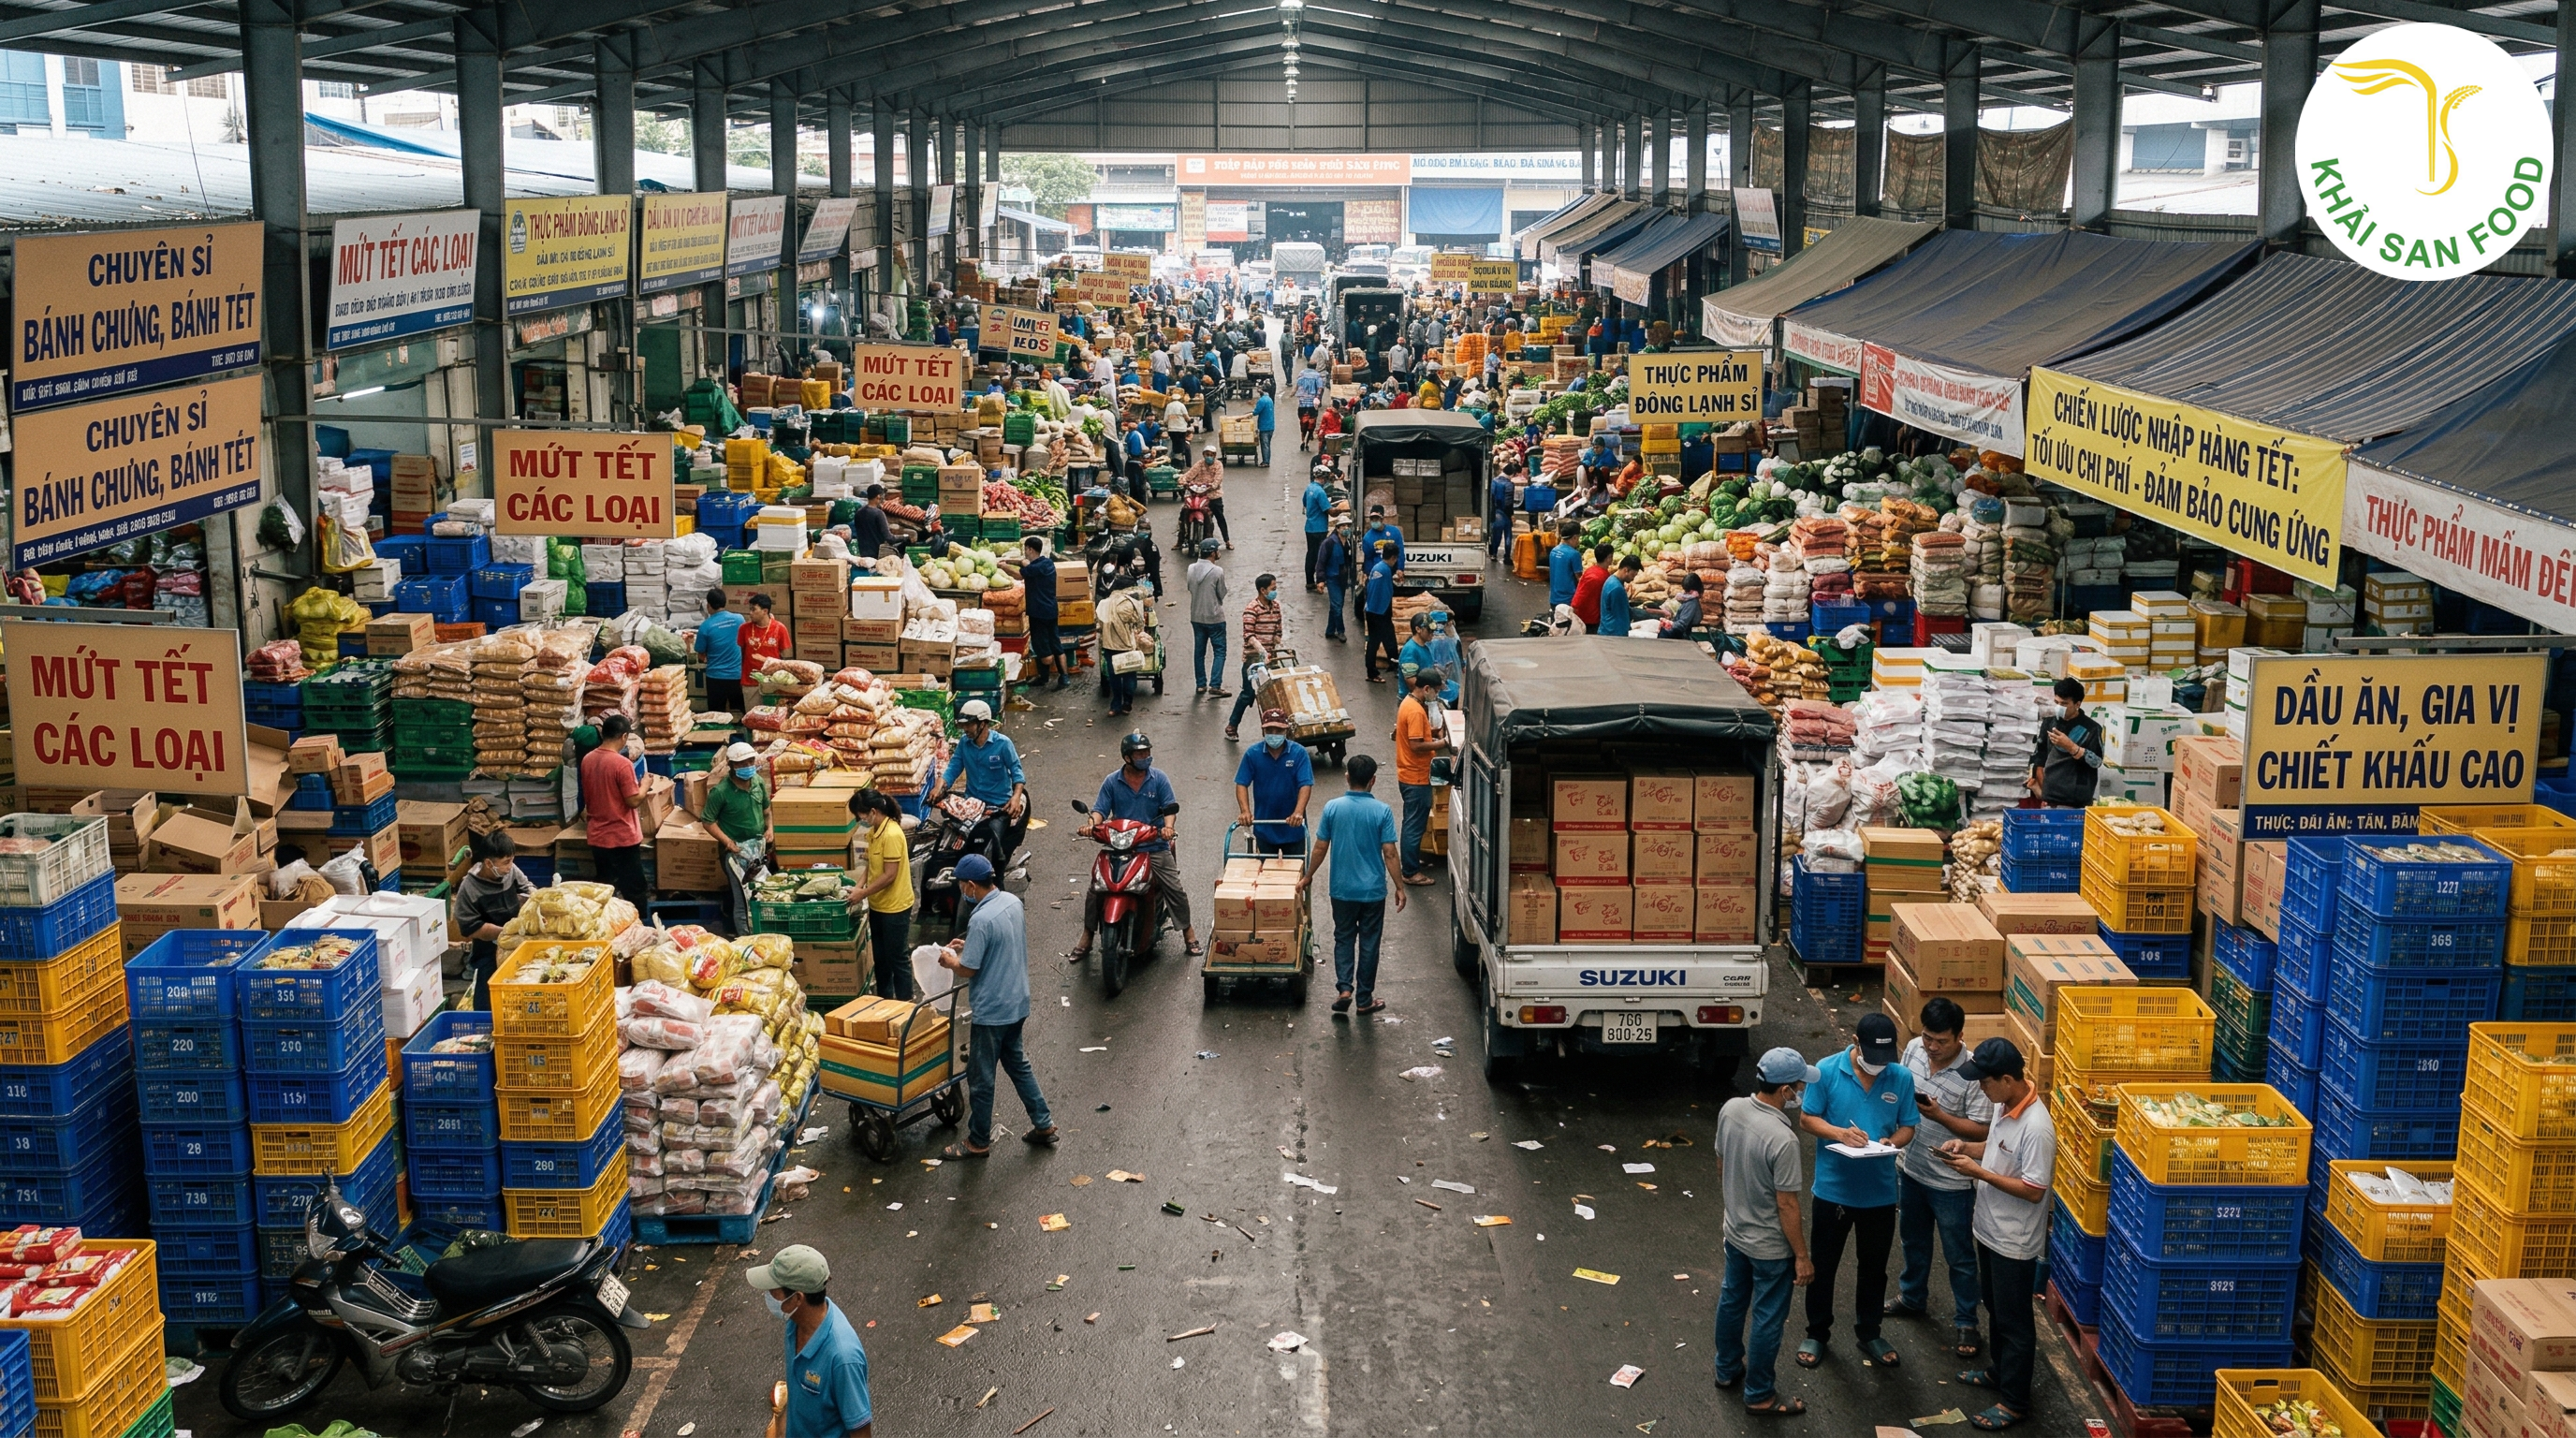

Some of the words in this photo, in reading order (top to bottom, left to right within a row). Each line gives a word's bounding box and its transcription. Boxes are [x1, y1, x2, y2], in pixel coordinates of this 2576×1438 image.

[88, 241, 184, 286] CHUYÊN
[191, 234, 213, 276] SỈ
[338, 232, 374, 286] MỨT
[380, 222, 408, 280] TẾT
[411, 226, 439, 275] CÁC
[443, 232, 474, 277] LOẠI
[24, 305, 84, 363] BÁNH
[92, 300, 165, 353] CHƯNG,
[171, 289, 220, 341] BÁNH
[863, 352, 908, 375] MỨT
[915, 352, 953, 377] TẾT
[1644, 362, 1691, 388] THỰC
[1697, 354, 1748, 383] PHẨM
[862, 378, 901, 402] CÁC
[909, 385, 954, 407] LOẠI
[1635, 391, 1683, 414] ĐÔNG
[1689, 394, 1734, 418] LẠNH
[1740, 386, 1758, 412] SỈ
[86, 402, 180, 452] CHUYÊN
[186, 389, 208, 431] SỈ
[2055, 387, 2098, 430] CHIẾN
[2101, 403, 2143, 448] LƯỢC
[2147, 413, 2195, 463] NHẬP
[2199, 423, 2249, 478] HÀNG
[2256, 436, 2300, 494] TẾT:
[24, 471, 84, 527] BÁNH
[91, 457, 165, 510] CHƯNG,
[170, 441, 219, 491] BÁNH
[509, 441, 582, 478] MỨT
[593, 440, 656, 480] TẾT
[506, 486, 574, 522] CÁC
[585, 494, 659, 530] LOẠI
[2032, 426, 2053, 467] TỐI
[2055, 438, 2073, 475] ƯU
[2076, 448, 2101, 485] CHI
[2104, 456, 2133, 495] PHÍ
[2144, 462, 2182, 514] ĐẢM
[2187, 476, 2224, 528] BẢO
[2228, 498, 2281, 550] CUNG
[2285, 508, 2330, 568] ỨNG
[1405, 553, 1452, 563] UZUKI
[2366, 494, 2419, 551] THỰC
[2421, 504, 2476, 570] PHẨM
[2479, 530, 2533, 592] MẤM
[2538, 549, 2576, 609] ĐÊ
[30, 645, 121, 700] MỨT
[134, 643, 213, 705] TẾT
[2274, 668, 2343, 726] DẦU
[2351, 676, 2408, 733] ĂN,
[2421, 684, 2475, 725] GIA
[2488, 684, 2520, 733] VỊ
[33, 712, 116, 768] CÁC
[130, 726, 226, 782] LOẠI
[2257, 733, 2352, 790] CHIẾT
[2363, 733, 2450, 789] KHẤU
[2460, 749, 2525, 789] CAO
[1579, 969, 1687, 986] SUZUKI
[177, 1092, 198, 1103] 200
[186, 1143, 201, 1154] 28
